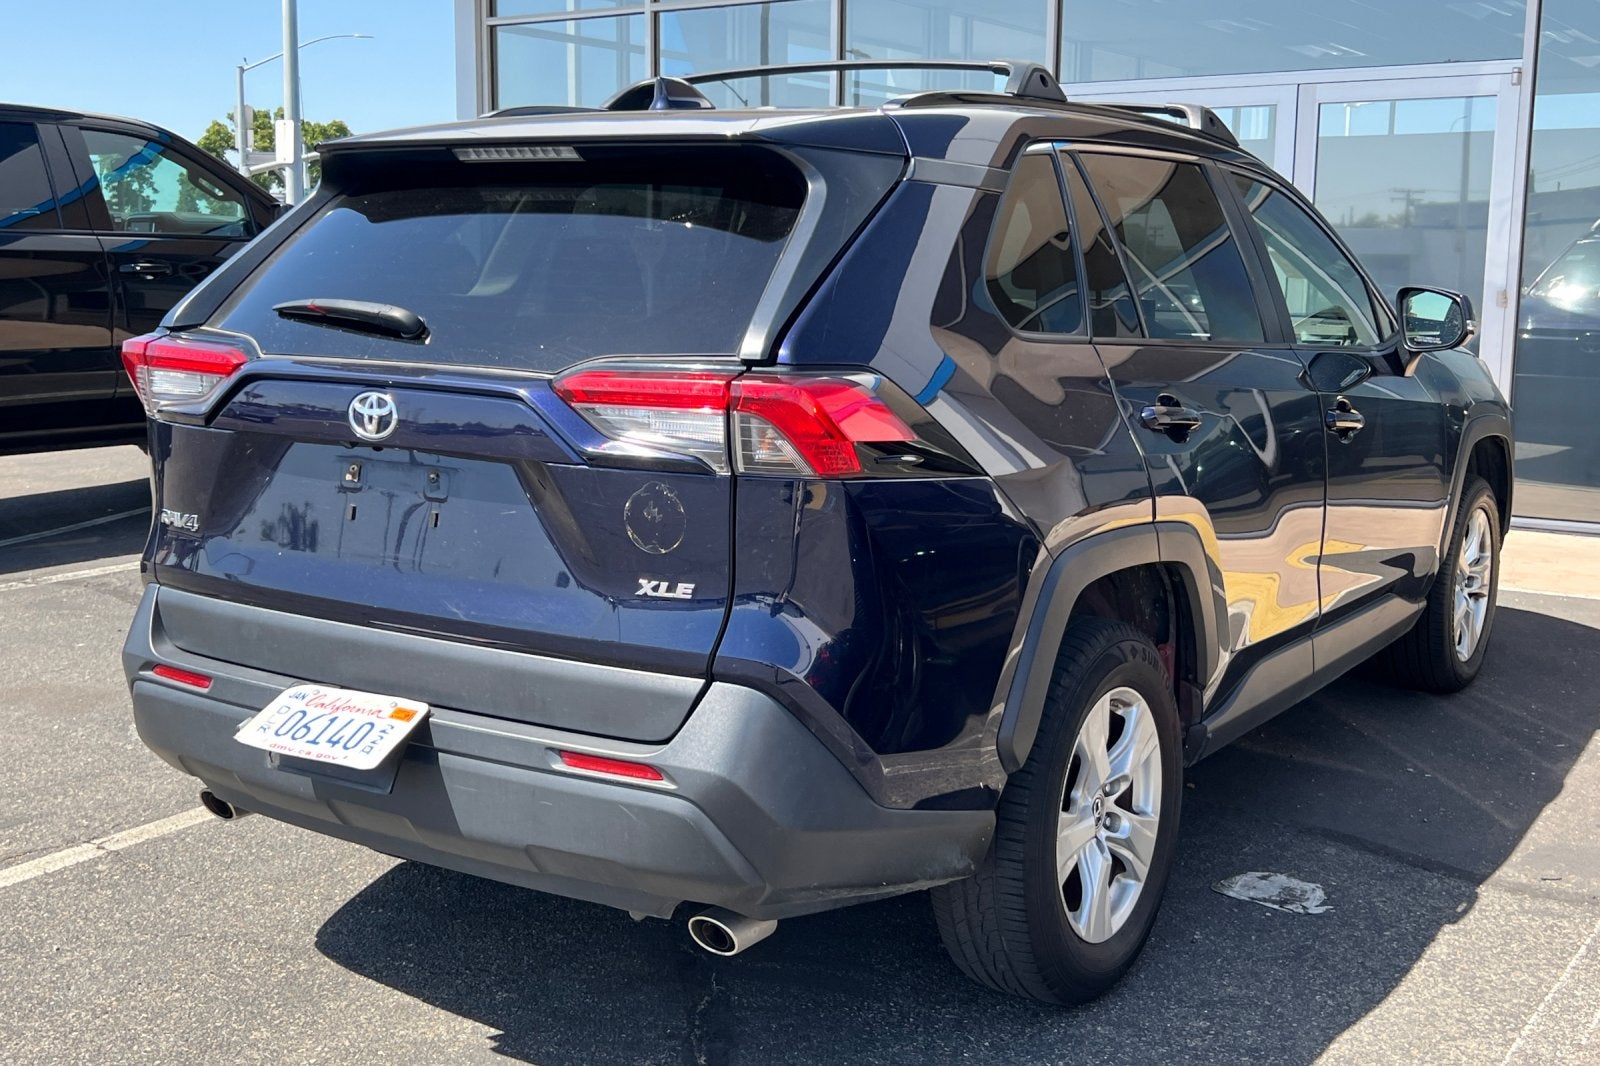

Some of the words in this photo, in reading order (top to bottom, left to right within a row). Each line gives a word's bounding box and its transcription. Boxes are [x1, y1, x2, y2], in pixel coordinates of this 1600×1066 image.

[161, 508, 200, 532] RAV4
[634, 578, 696, 600] XLE
[288, 692, 309, 702] JAN
[305, 694, 388, 720] California
[274, 709, 376, 751] 06140
[269, 743, 339, 761] dmv.ca.gov
